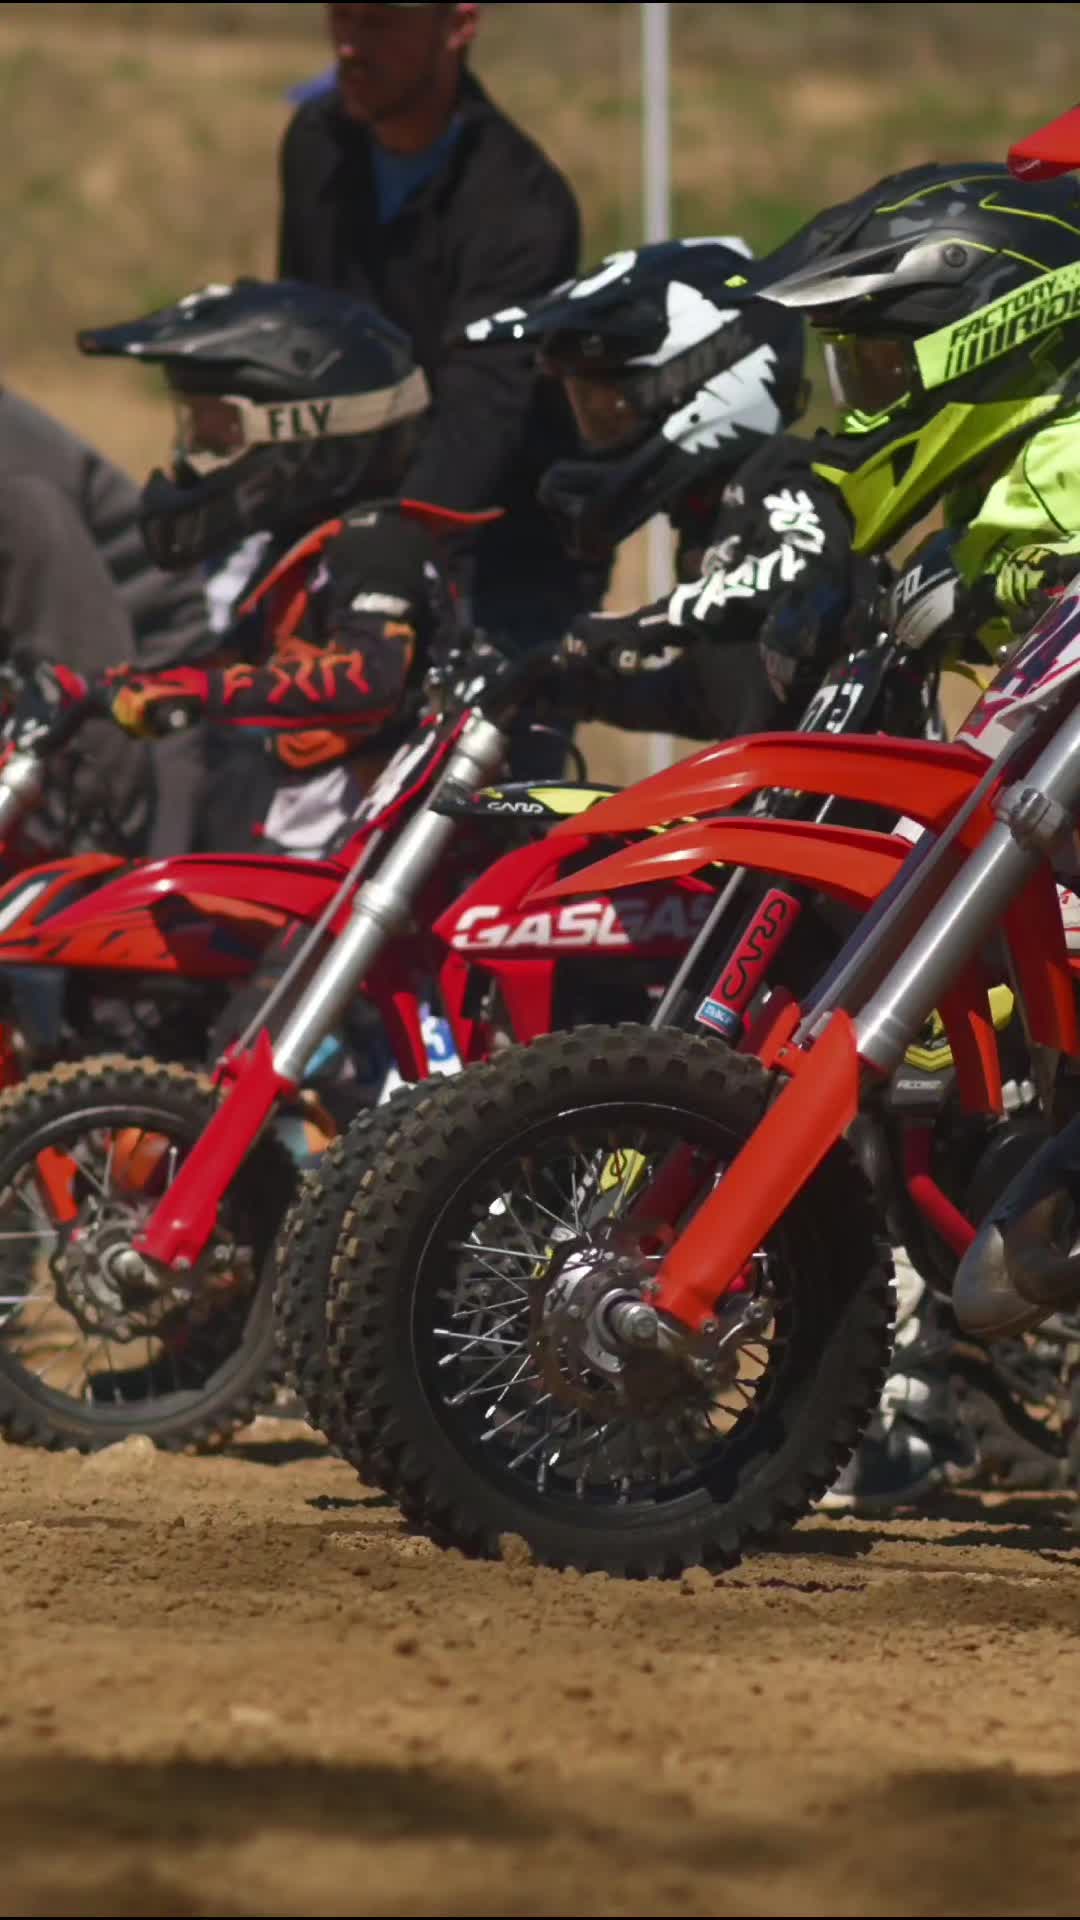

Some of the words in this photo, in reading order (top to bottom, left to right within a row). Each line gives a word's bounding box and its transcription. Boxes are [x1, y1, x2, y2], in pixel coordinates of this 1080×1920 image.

[950, 276, 1057, 347] FACTORY
[269, 400, 332, 438] FLY
[222, 651, 372, 704] FXR
